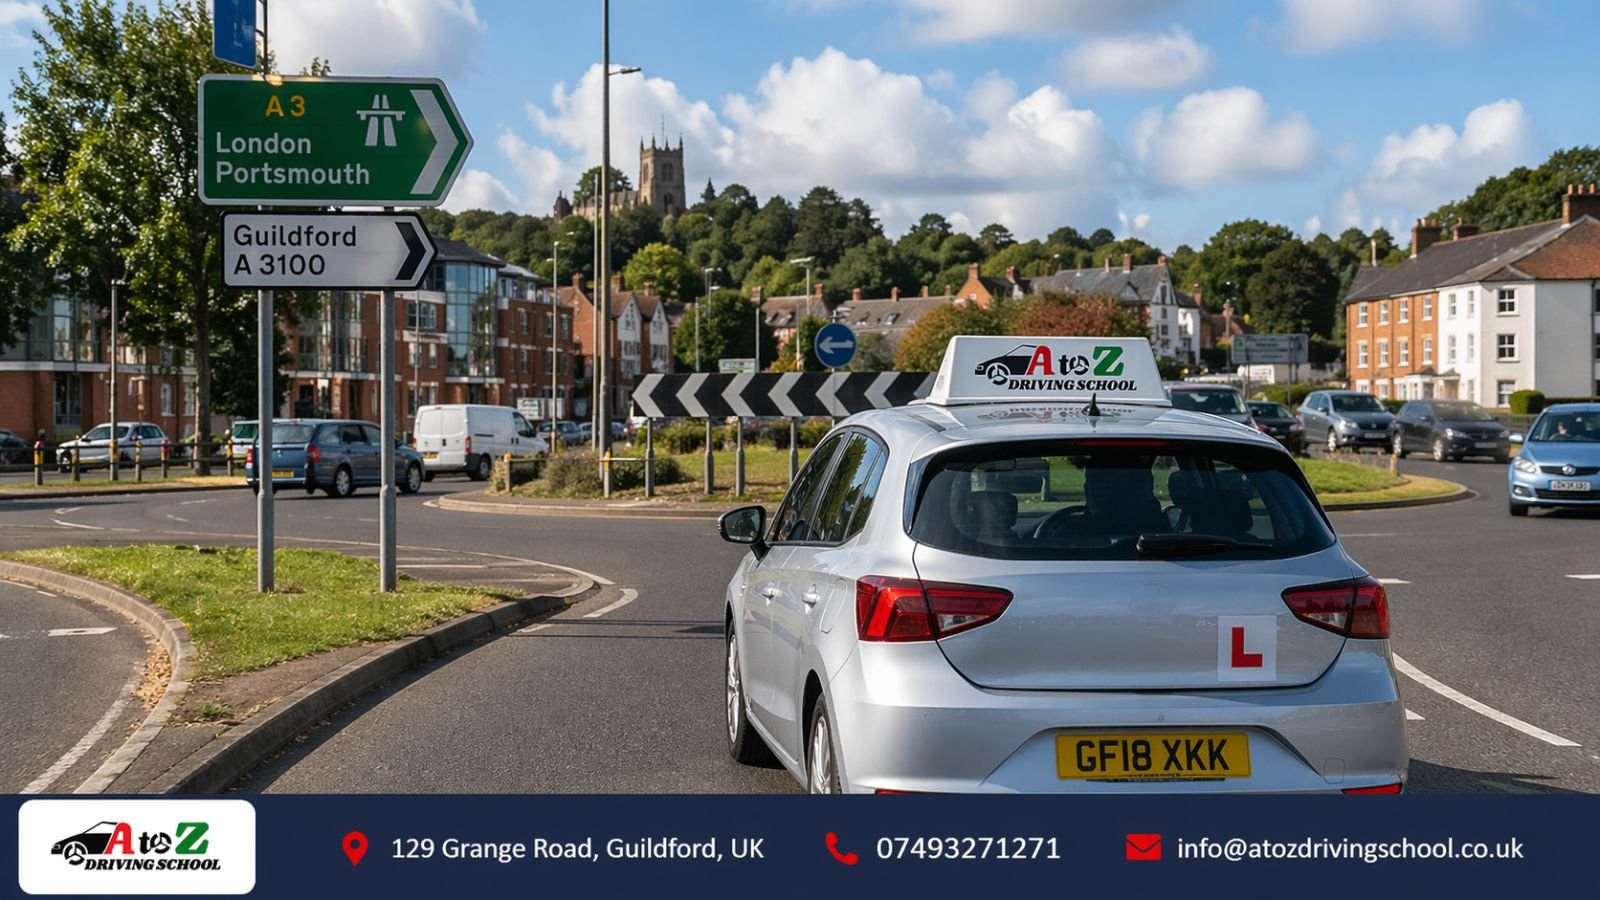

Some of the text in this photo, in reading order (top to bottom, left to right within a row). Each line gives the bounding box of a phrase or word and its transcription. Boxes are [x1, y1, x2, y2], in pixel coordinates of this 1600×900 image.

[216, 132, 312, 154] London
[216, 161, 370, 185] Portsmouth
[233, 224, 357, 247] Guildford
[1026, 345, 1124, 377] A to Z
[1008, 379, 1137, 391] DRIVING SCHOOL
[1231, 626, 1264, 668] L
[1075, 738, 1230, 773] GF18 XKK
